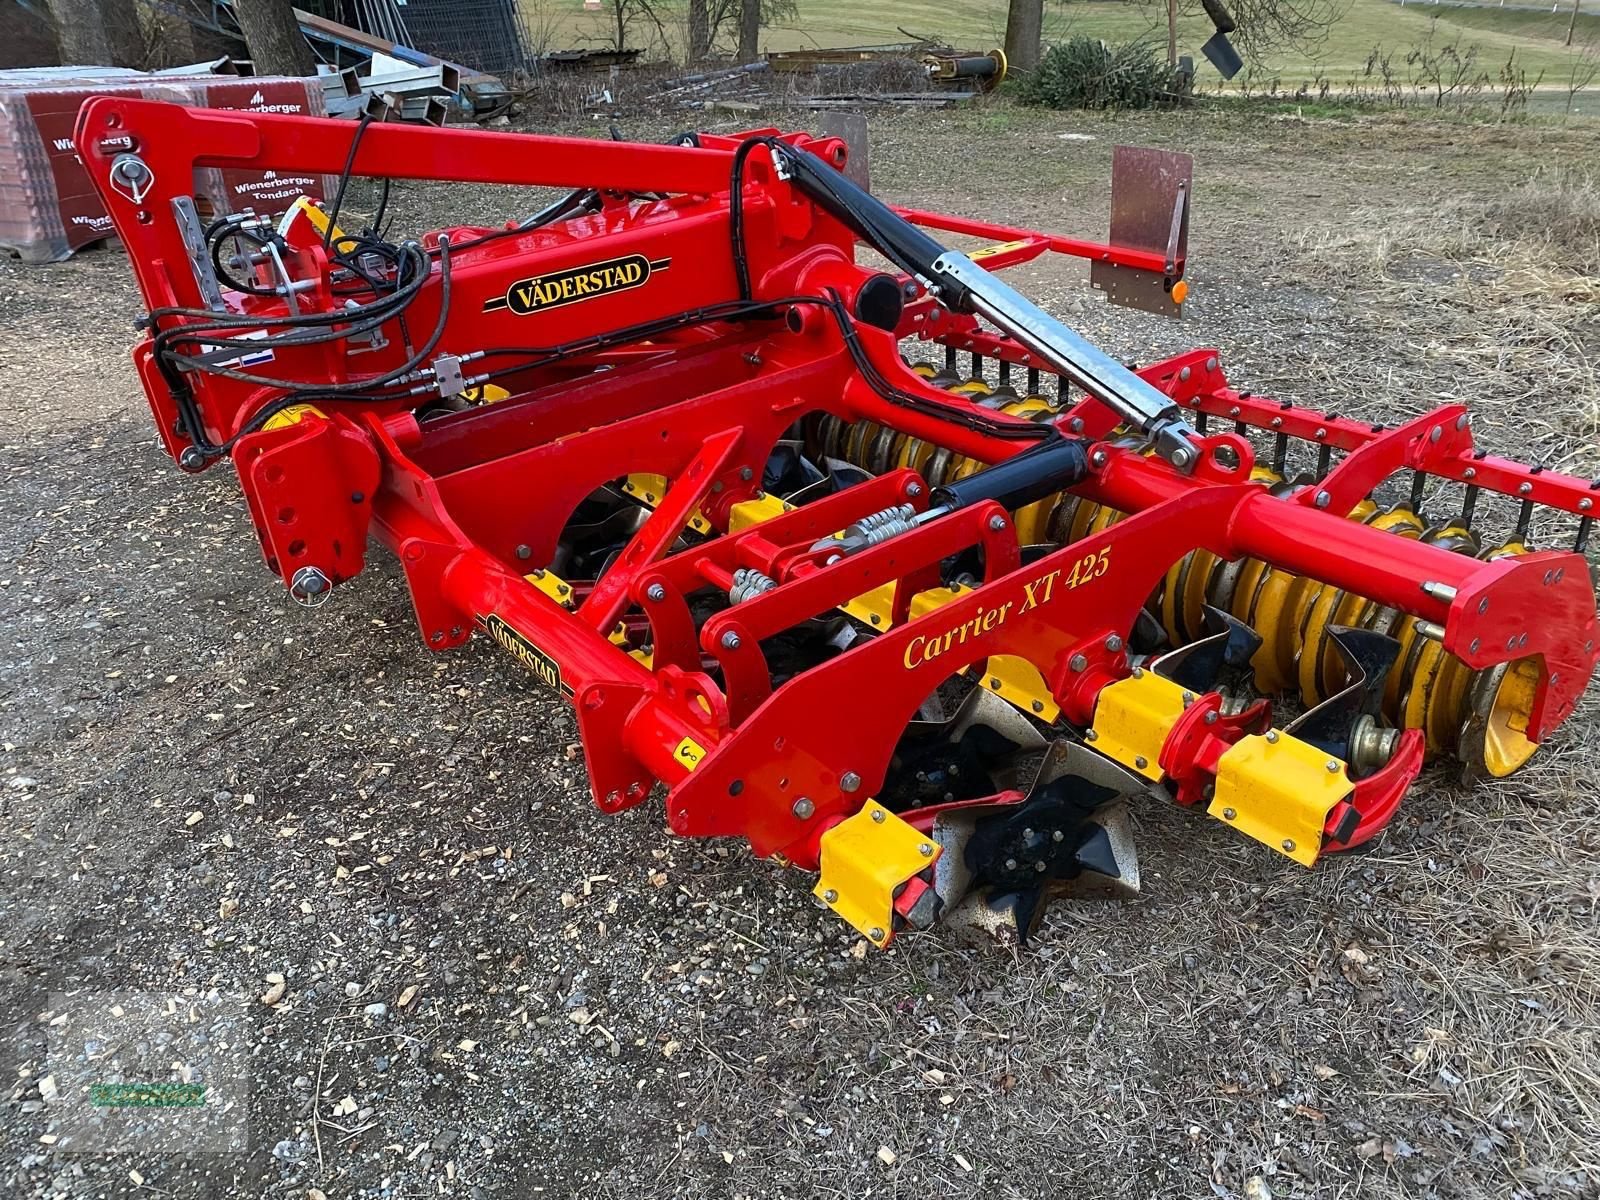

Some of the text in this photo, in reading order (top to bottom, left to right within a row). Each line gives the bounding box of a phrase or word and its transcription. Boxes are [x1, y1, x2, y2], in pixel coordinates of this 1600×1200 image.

[234, 177, 315, 193] Wienerberger
[252, 187, 304, 200] Tondach
[517, 262, 642, 308] VÄDERSTAD
[903, 545, 1112, 670] Carrier XT 425
[491, 622, 557, 688] VÄDERSTAD
